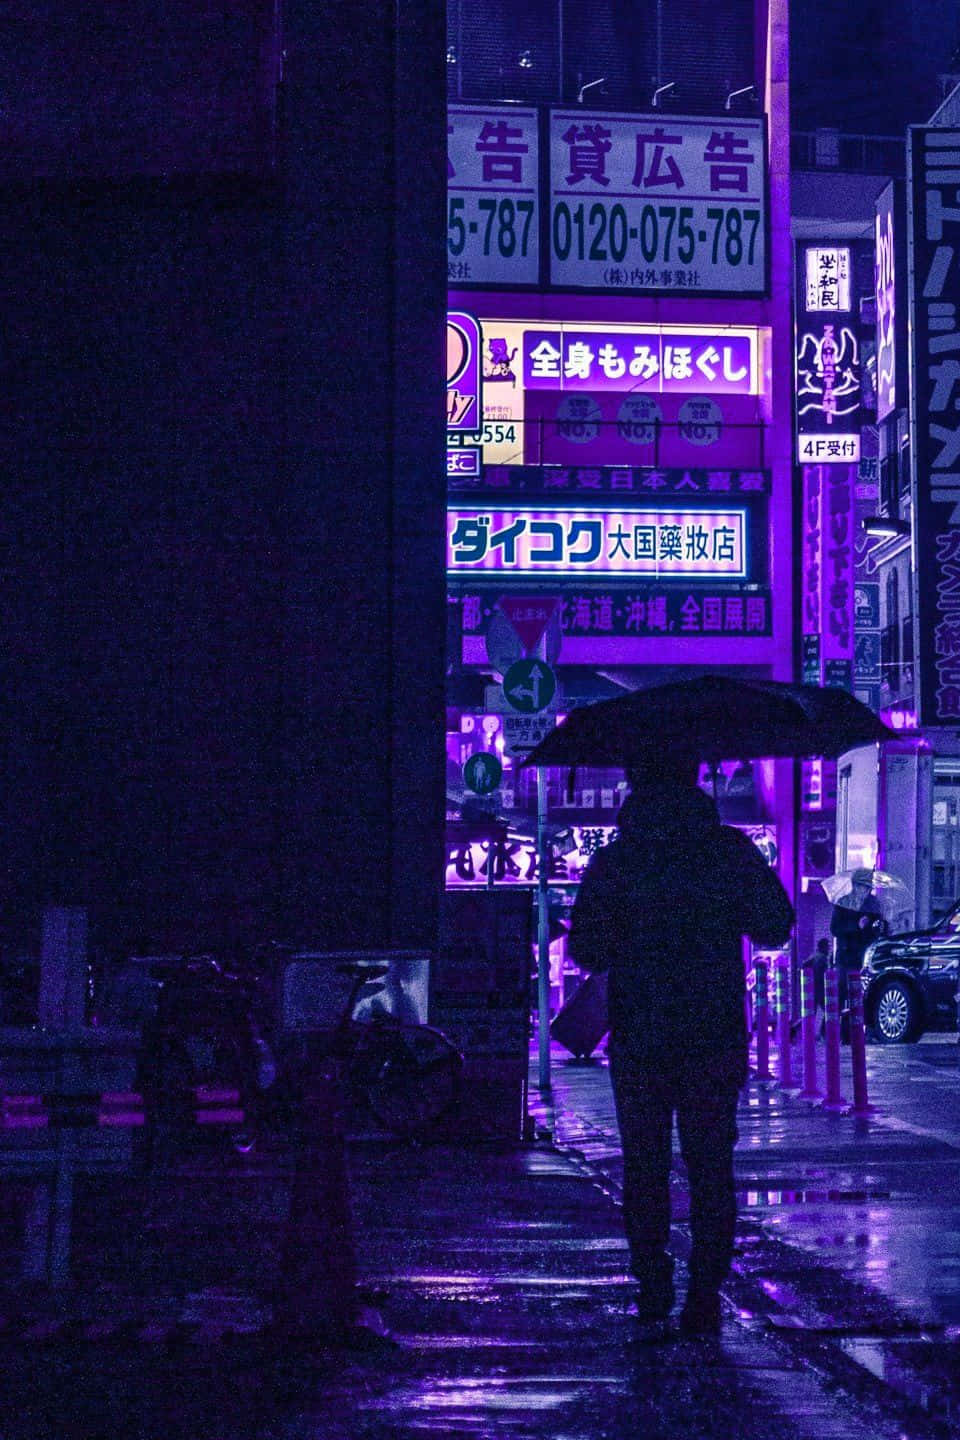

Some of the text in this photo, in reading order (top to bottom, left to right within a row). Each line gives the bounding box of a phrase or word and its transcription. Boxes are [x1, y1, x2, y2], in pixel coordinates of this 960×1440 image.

[447, 121, 529, 183] 告
[562, 123, 755, 193] 貸広告
[603, 266, 701, 287] (株)内外事業社
[529, 339, 749, 383] 全身もみほぐし
[802, 440, 857, 457] 4F受付
[452, 516, 602, 562] ダイコク
